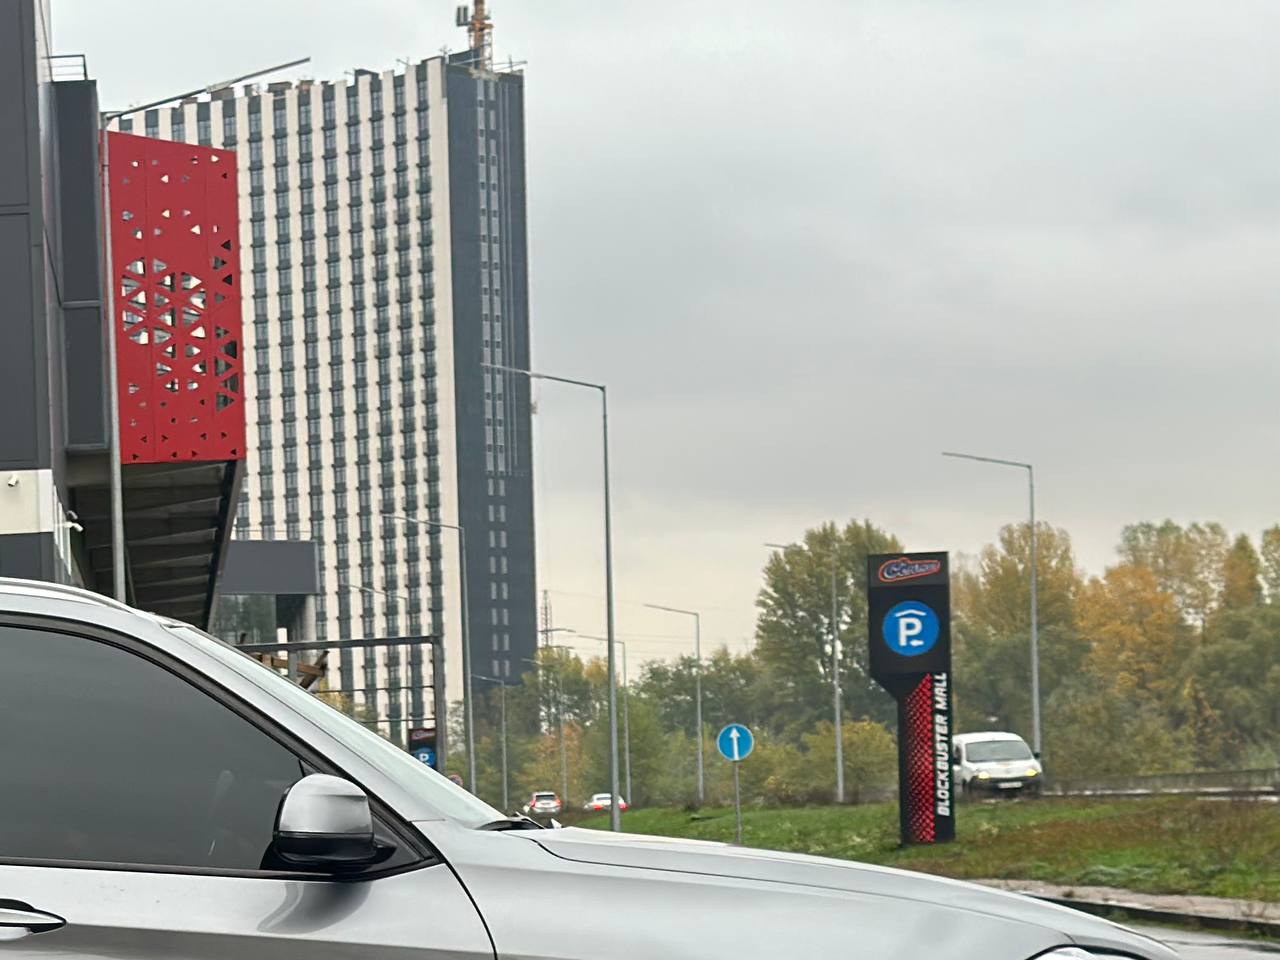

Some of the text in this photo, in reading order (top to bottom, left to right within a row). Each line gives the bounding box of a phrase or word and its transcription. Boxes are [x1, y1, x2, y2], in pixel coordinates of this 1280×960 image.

[899, 617, 923, 646] P
[933, 672, 950, 817] BLOCKBUSTER MALL
